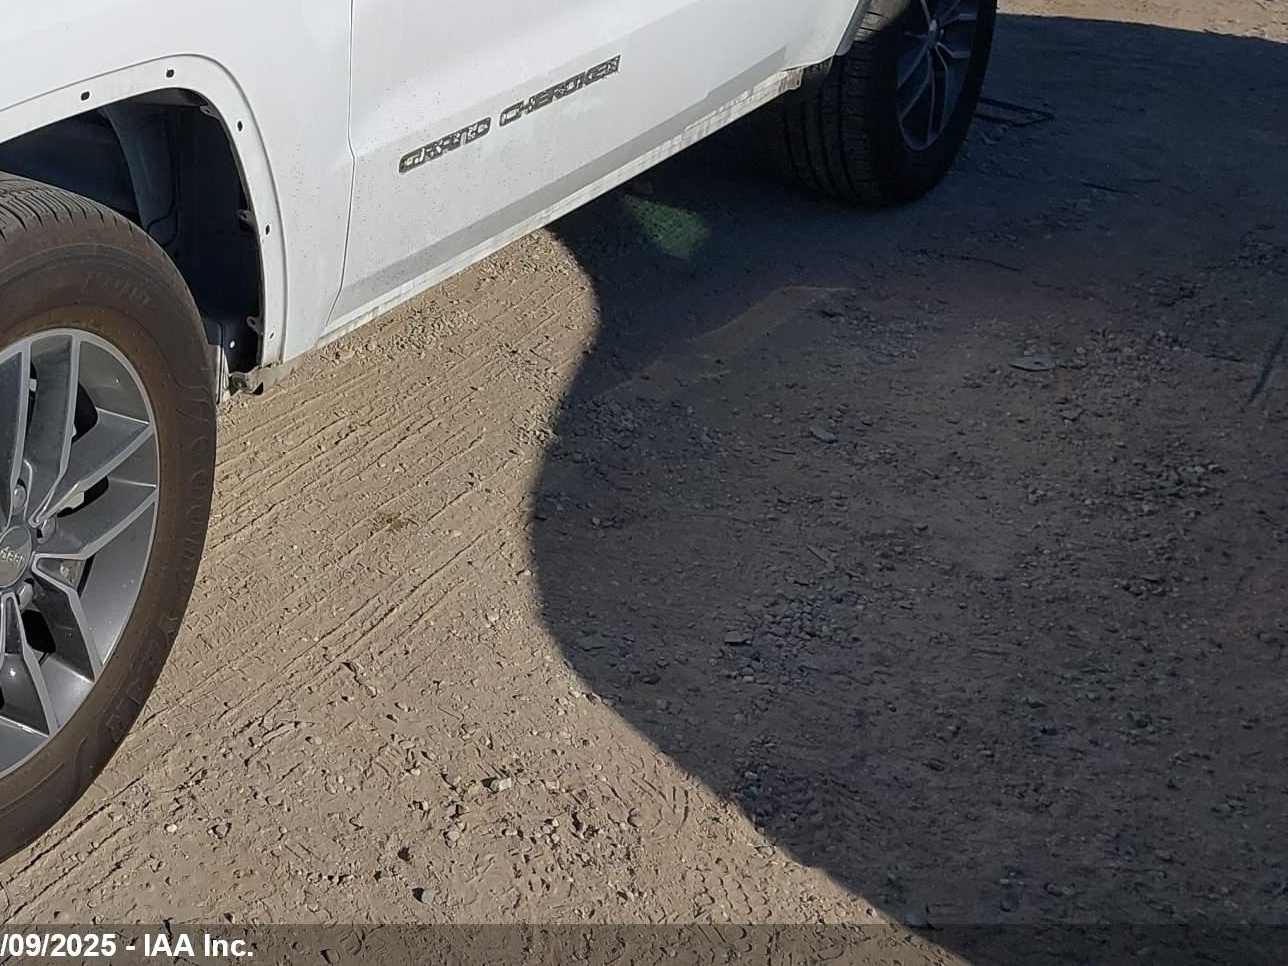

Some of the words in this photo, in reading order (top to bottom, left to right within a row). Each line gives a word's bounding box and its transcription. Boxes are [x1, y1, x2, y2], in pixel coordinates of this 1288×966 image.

[398, 117, 491, 174] GRAND
[499, 54, 621, 127] CHEROKEE
[0, 546, 24, 569] Jeep
